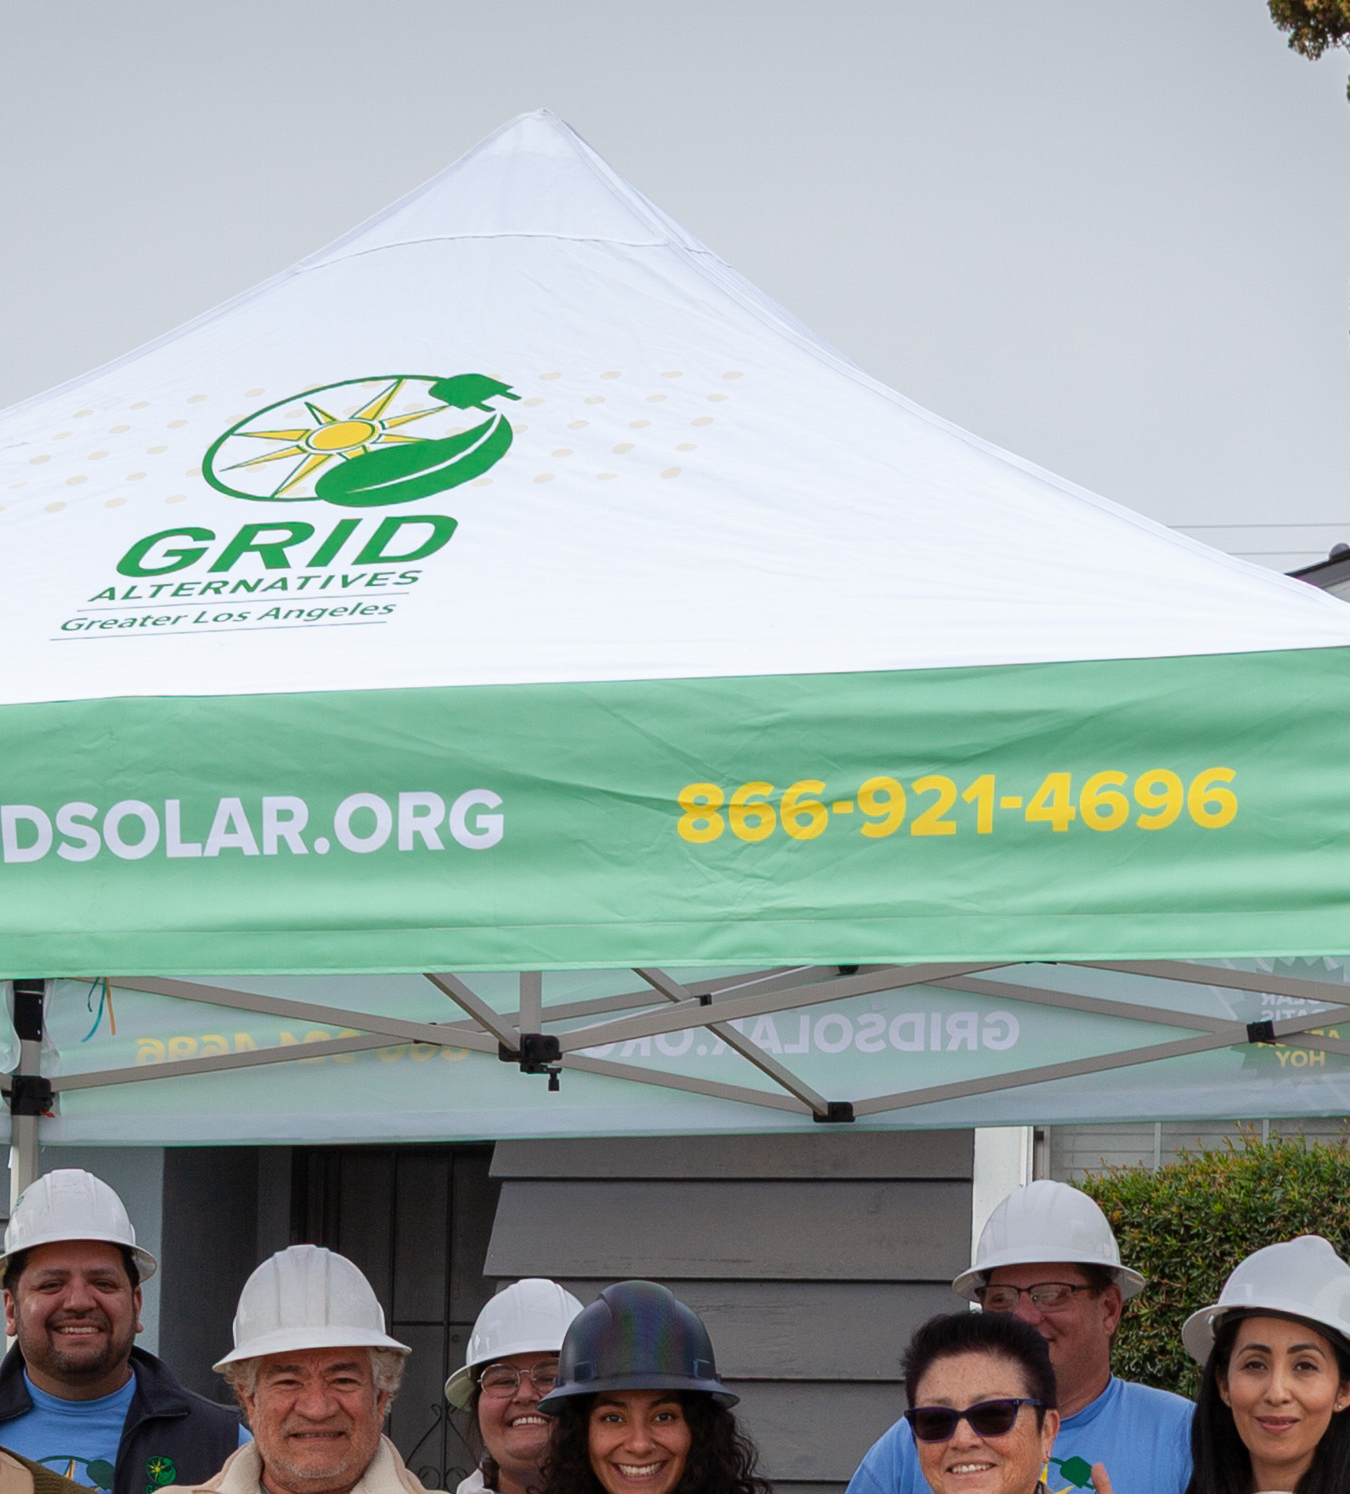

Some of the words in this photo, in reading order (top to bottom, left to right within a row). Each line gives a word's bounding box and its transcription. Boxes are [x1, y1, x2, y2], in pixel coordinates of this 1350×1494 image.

[116, 514, 458, 578] GRID
[87, 570, 424, 602] ALTERNATIVES
[60, 614, 188, 632] Greater
[192, 610, 251, 624] Los
[257, 602, 397, 622] Angeles
[677, 767, 1239, 844] 866-921-4696
